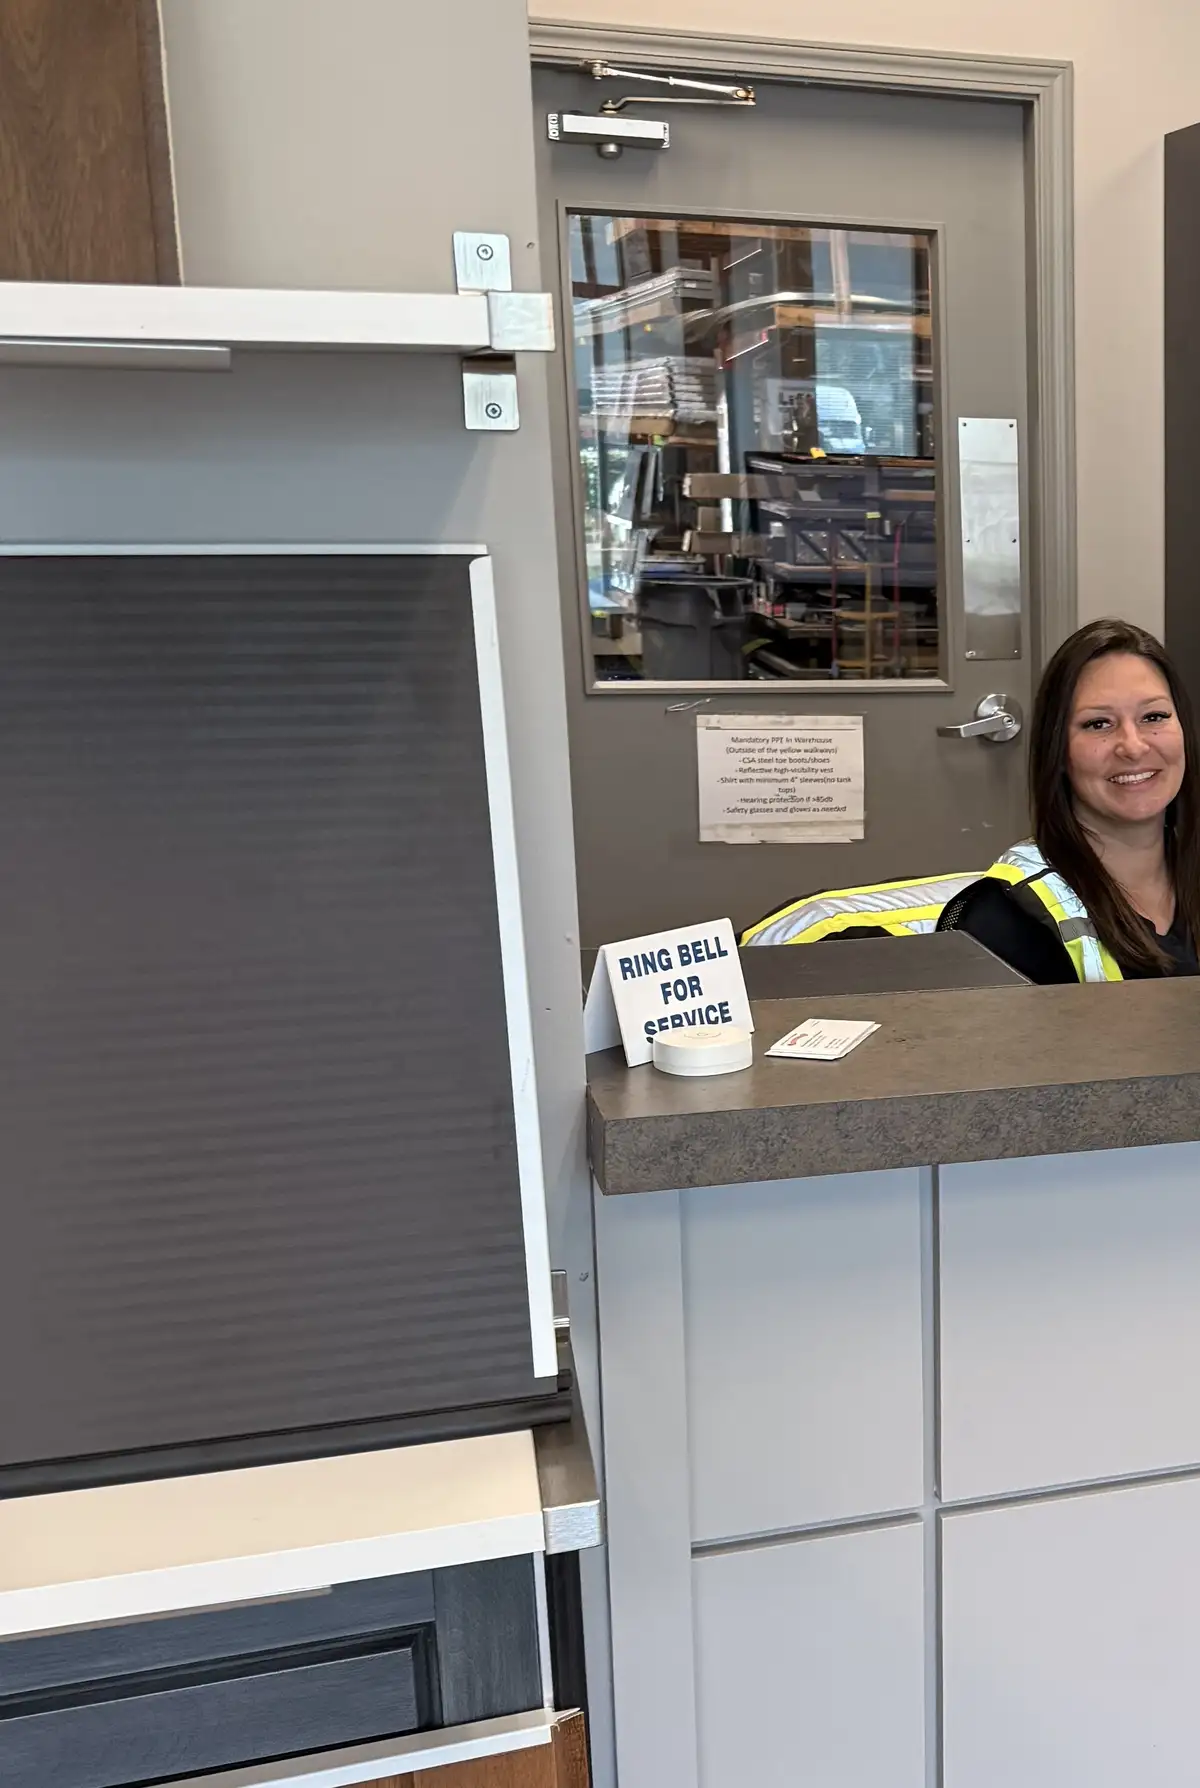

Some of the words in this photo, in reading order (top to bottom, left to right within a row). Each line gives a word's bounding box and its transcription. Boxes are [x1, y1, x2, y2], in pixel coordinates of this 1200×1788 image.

[730, 736, 770, 744] Mandatory
[779, 746, 802, 754] yellow
[788, 756, 831, 764] boots/shoes
[618, 948, 673, 981] RING
[676, 936, 729, 967] BELL
[660, 975, 704, 1005] FOR
[643, 1001, 733, 1044] SERVICE
